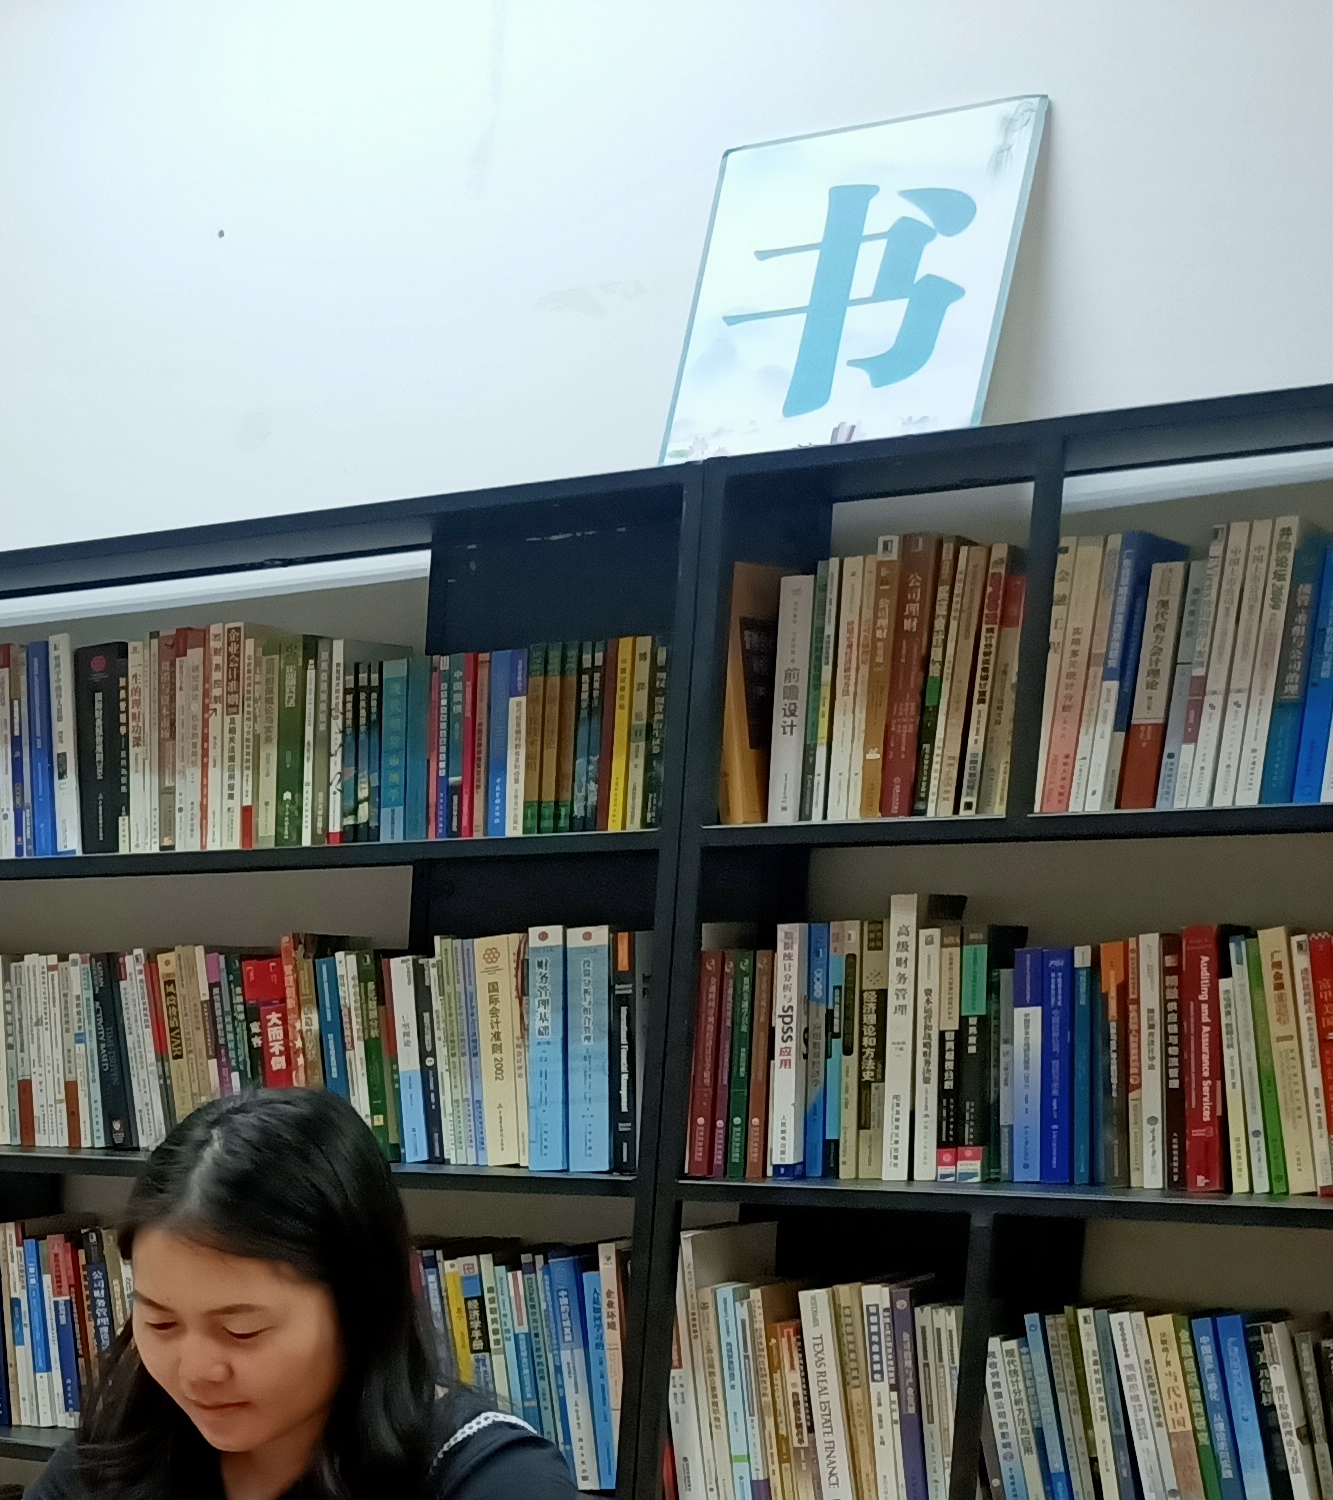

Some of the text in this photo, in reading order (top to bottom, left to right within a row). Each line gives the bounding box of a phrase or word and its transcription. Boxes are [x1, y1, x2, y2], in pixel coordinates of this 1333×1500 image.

[722, 184, 978, 418] 书
[893, 923, 911, 1017] 高级财务管理
[266, 1011, 287, 1072] 大而不倒
[812, 1333, 841, 1489] TEXAS REAL ESTATE FINANCE
